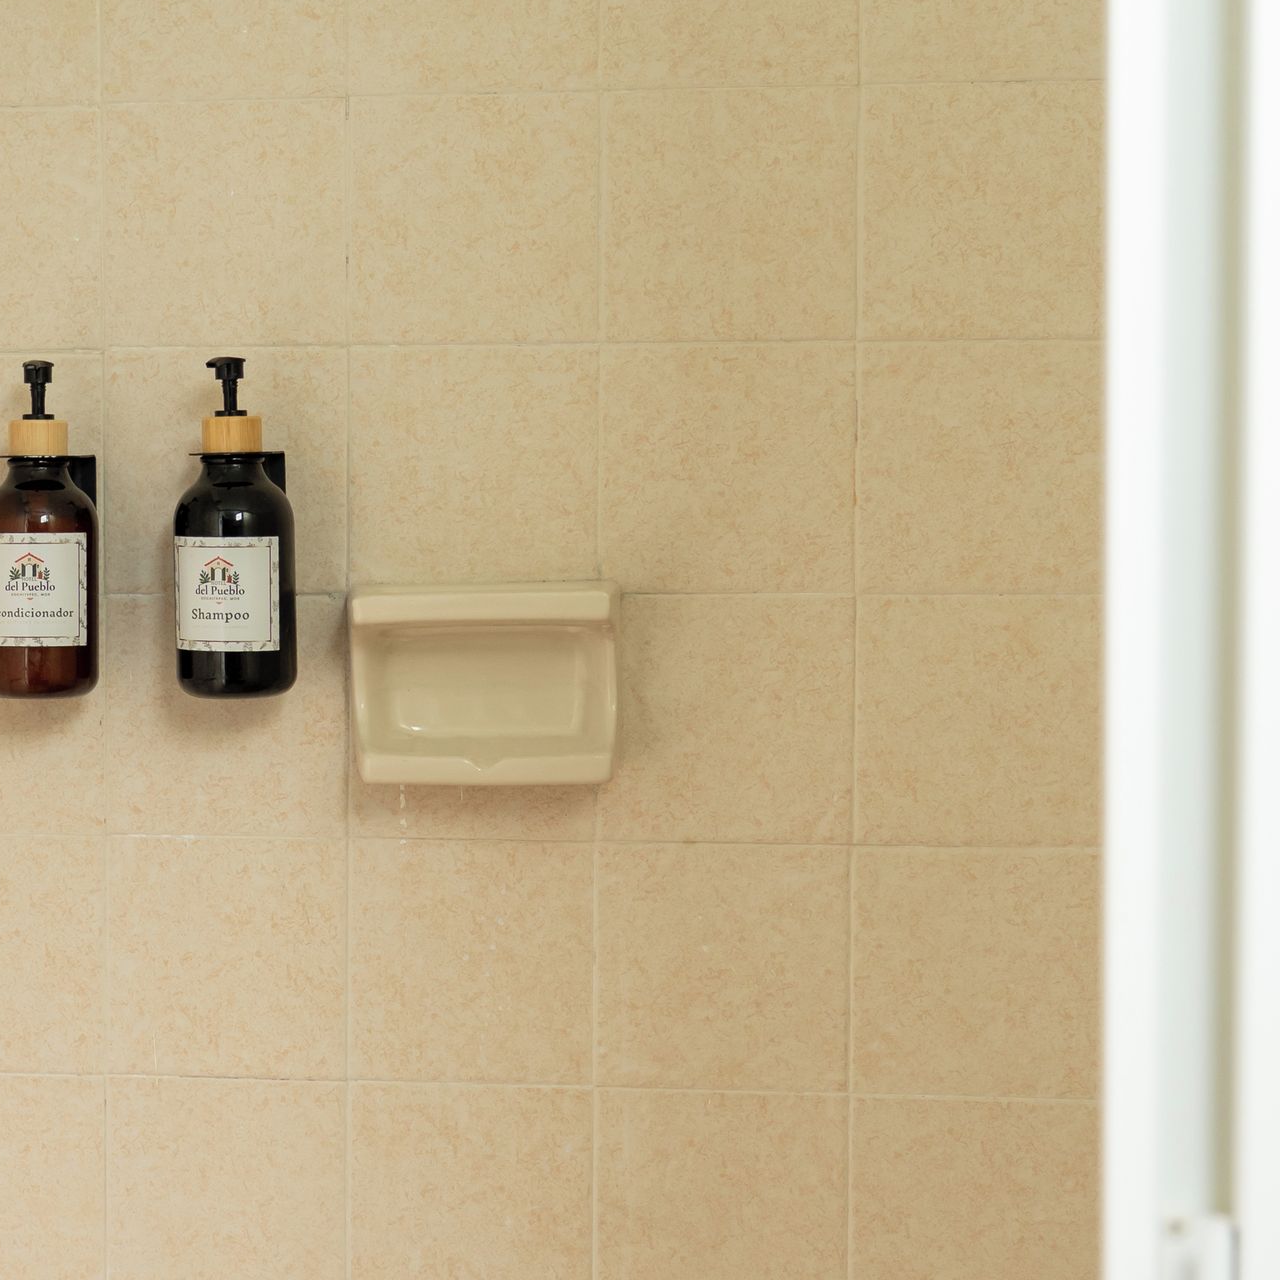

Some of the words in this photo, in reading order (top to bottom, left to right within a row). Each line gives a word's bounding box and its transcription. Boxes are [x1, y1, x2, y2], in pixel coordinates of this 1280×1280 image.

[5, 581, 18, 591] del
[22, 580, 55, 591] Pueblo
[195, 585, 207, 595] del
[211, 584, 245, 595] Pueblo
[191, 608, 250, 623] Shampoo
